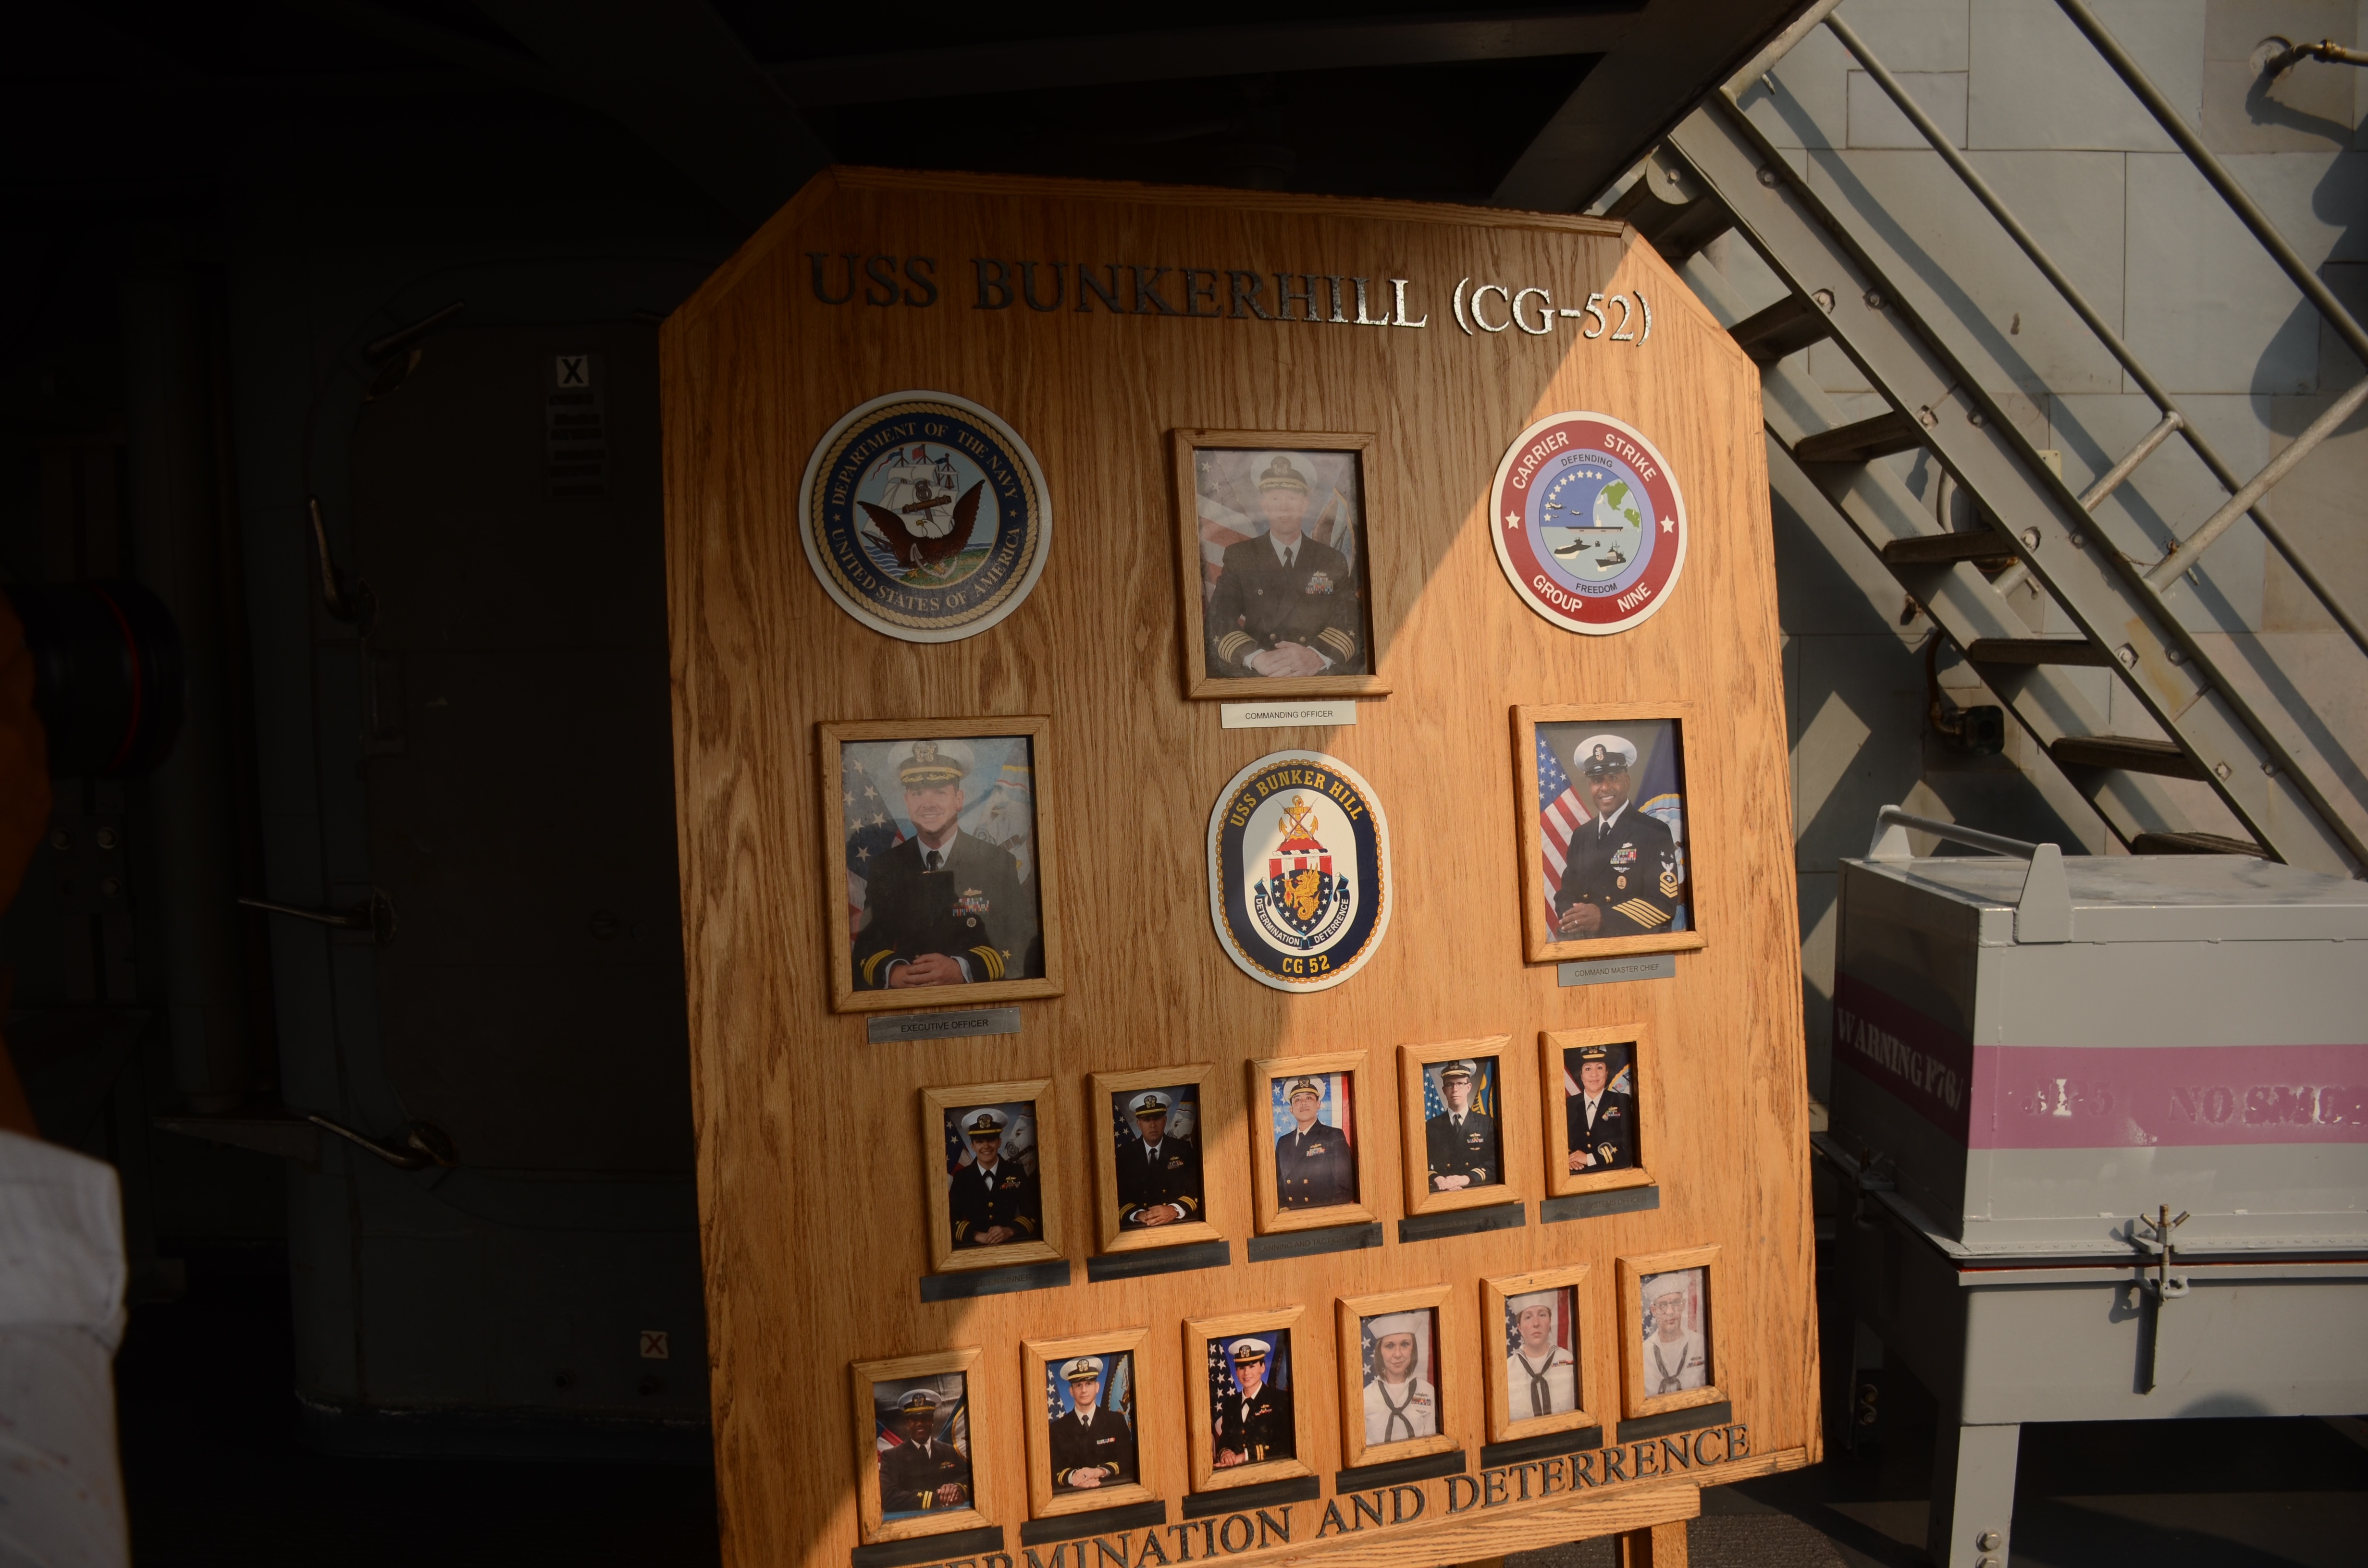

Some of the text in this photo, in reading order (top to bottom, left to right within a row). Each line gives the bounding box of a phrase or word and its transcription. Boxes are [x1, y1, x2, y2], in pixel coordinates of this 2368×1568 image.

[805, 251, 1653, 346] USS BUNKERHILL (CG-52)
[561, 358, 584, 384] X
[832, 422, 1018, 507] DEPARTMENT OF THE NAVY
[1512, 431, 1657, 490] CARRIER STRIKE
[1560, 454, 1613, 468] DEFENDING
[832, 527, 1021, 612] UNITED STATES OF AMERICA
[1533, 575, 1651, 613] GROUP NINE
[1575, 582, 1617, 594] FREEDOM
[1245, 711, 1298, 720] COMMANDING
[1230, 770, 1364, 827] USS BUNKER HILL
[1256, 898, 1300, 946] DETERMINATION
[1314, 898, 1349, 944] DETERRENCE
[1282, 955, 1330, 974] CG 52
[1574, 968, 1610, 977] COMMAND
[1611, 965, 1638, 974] MASTER
[901, 1019, 988, 1033] EXECUTIVE OFFICER
[1837, 1006, 1923, 1089] WARNING
[1617, 1195, 1647, 1205] OFFICER
[1253, 1241, 1293, 1253] PLANNING
[1294, 1238, 1311, 1248] AND
[1313, 1236, 1344, 1245] TACTICS
[644, 1334, 665, 1355] X
[1260, 1488, 1293, 1499] OFFICER
[1316, 1485, 1426, 1538] AND
[1444, 1424, 1751, 1515] DETERRENCE
